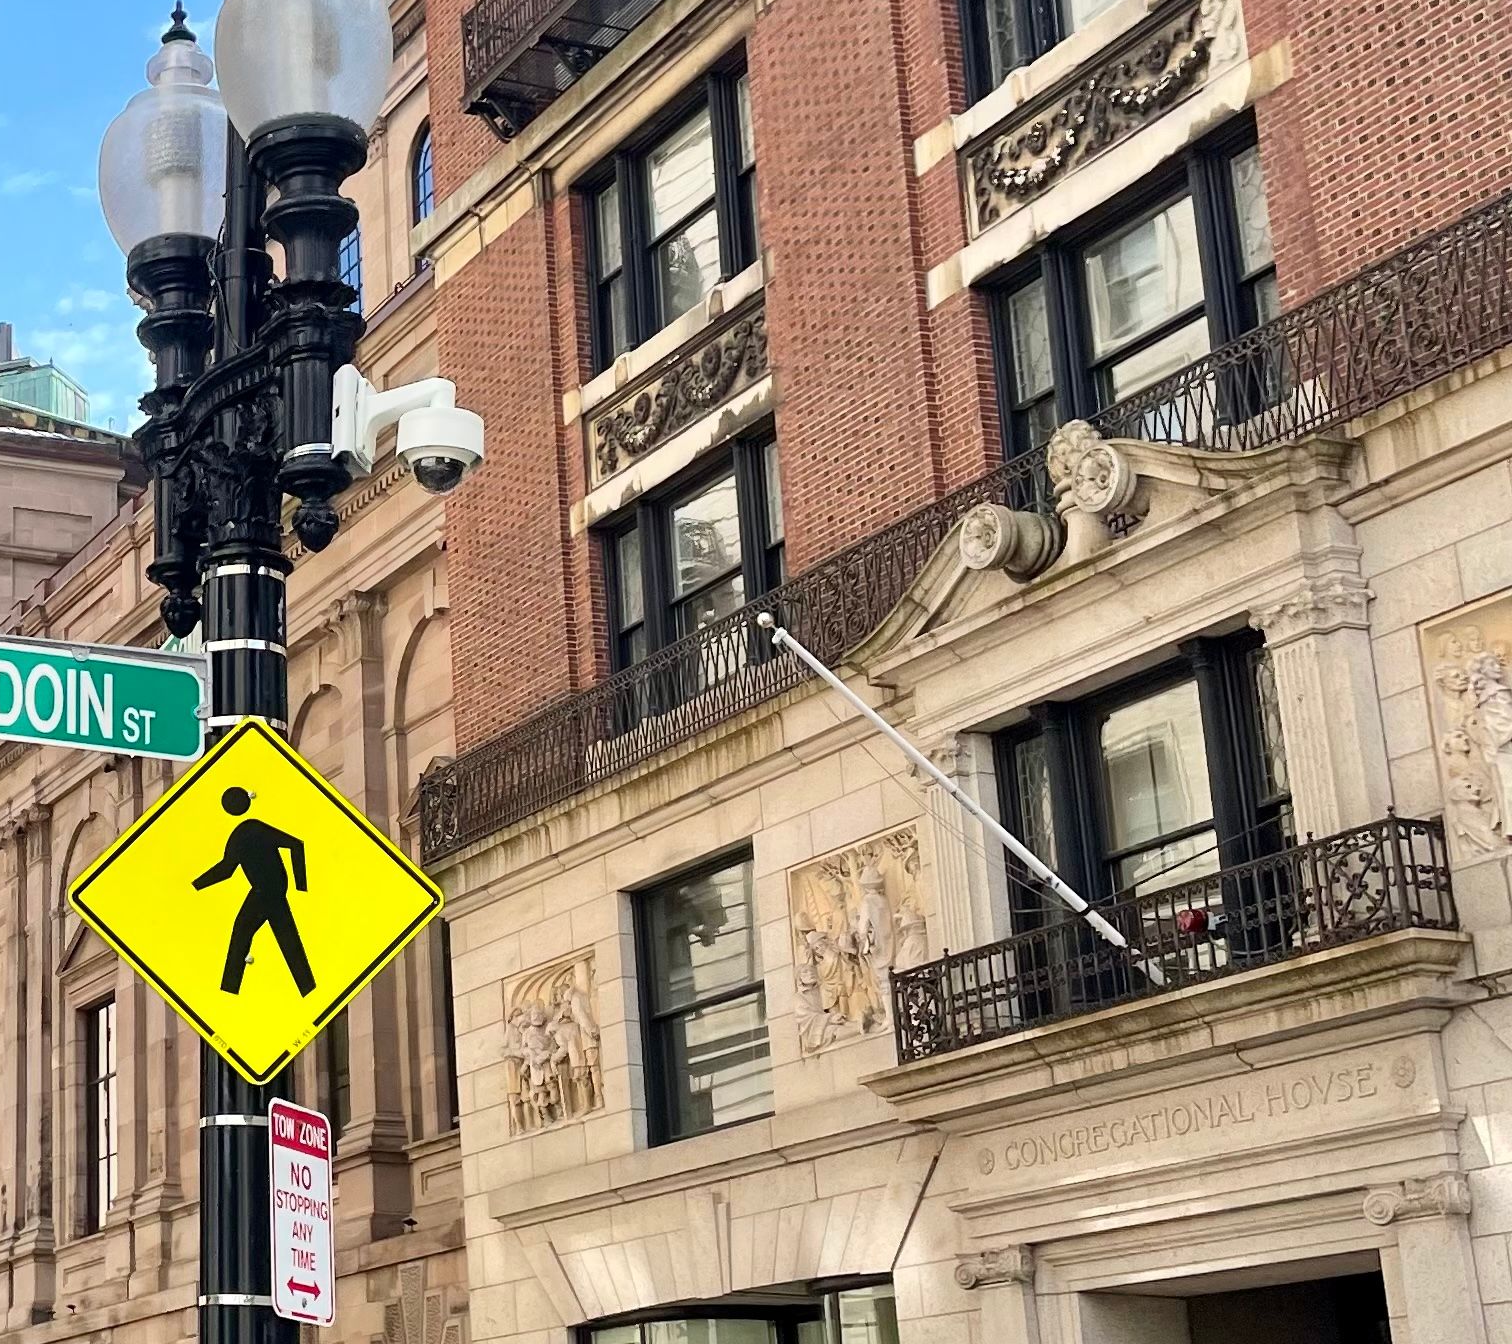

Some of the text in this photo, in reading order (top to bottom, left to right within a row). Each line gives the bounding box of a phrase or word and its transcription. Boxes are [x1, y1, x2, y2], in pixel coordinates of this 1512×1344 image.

[122, 707, 156, 745] ST
[273, 1113, 328, 1152] TOW ZONE
[1005, 1094, 1255, 1171] CONGREGATIONAL
[290, 1162, 312, 1190] NO
[276, 1189, 328, 1221] STOPPING
[292, 1220, 313, 1244] ANY
[291, 1247, 316, 1272] TIME
